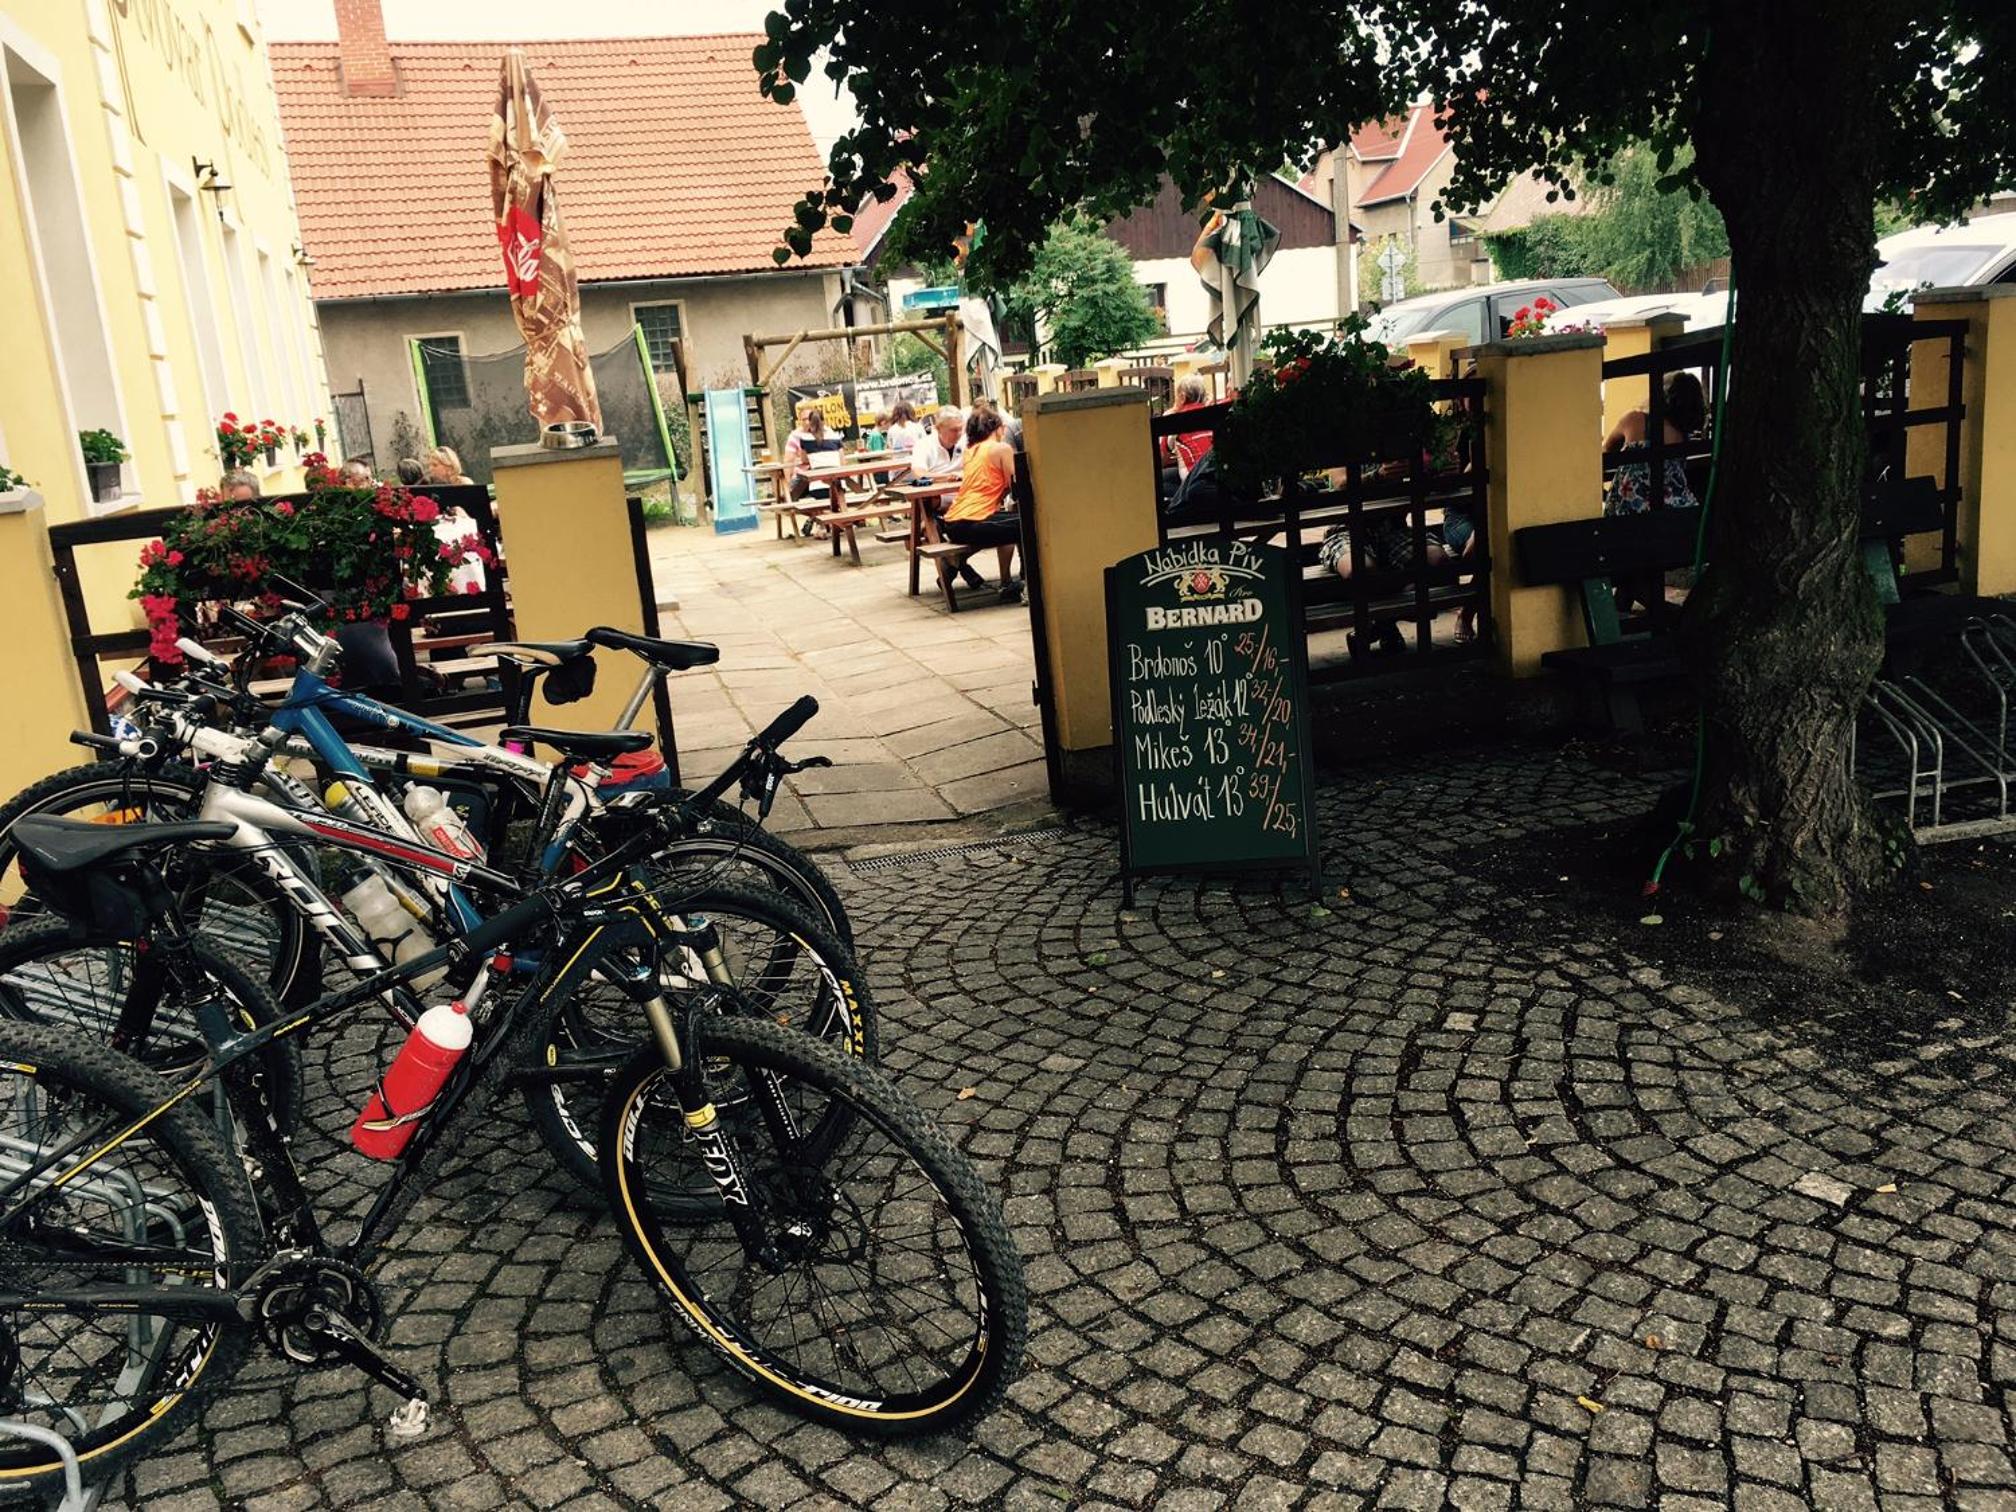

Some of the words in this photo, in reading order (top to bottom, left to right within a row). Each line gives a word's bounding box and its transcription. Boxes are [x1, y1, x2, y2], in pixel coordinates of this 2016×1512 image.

[1145, 598, 1263, 631] BERNARD
[1127, 641, 1197, 681] Brdonoš
[1135, 731, 1193, 770] Mikeš
[1139, 776, 1215, 821] Hulvát
[840, 979, 865, 1059] MAXXI
